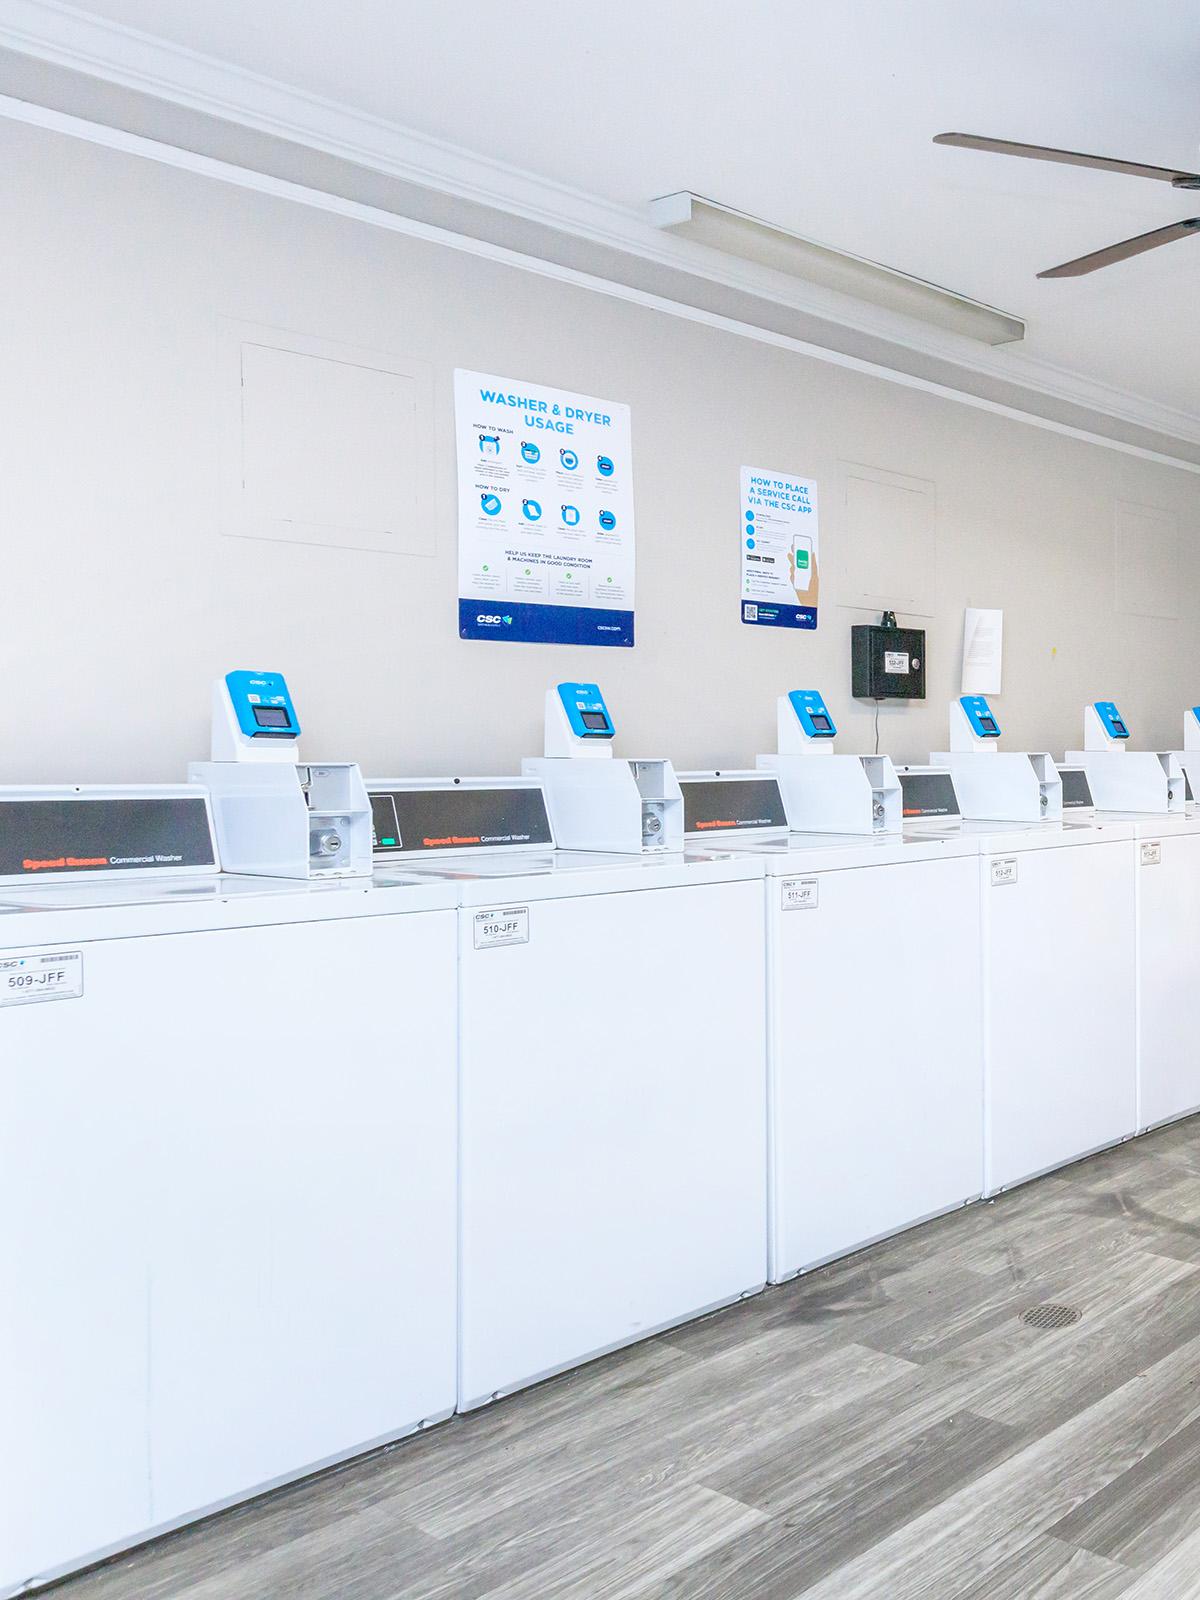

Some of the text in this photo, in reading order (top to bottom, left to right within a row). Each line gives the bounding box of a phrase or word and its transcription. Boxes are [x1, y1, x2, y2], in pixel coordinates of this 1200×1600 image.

[480, 389, 611, 426] WASHER & DRYER
[525, 415, 574, 435] USAGE
[751, 476, 808, 495] HOW TO PLACE
[757, 487, 790, 501] SERVICE
[792, 495, 810, 505] CALL
[748, 496, 812, 514] VIA THE CSC APP
[563, 561, 591, 569] CONDITION
[477, 614, 501, 624] CSC
[110, 855, 154, 864] Commercial
[155, 854, 183, 862] Washer
[788, 890, 812, 899] 511-JFF
[483, 922, 518, 934] 510-JFF
[8, 971, 65, 988] 509-JFF
